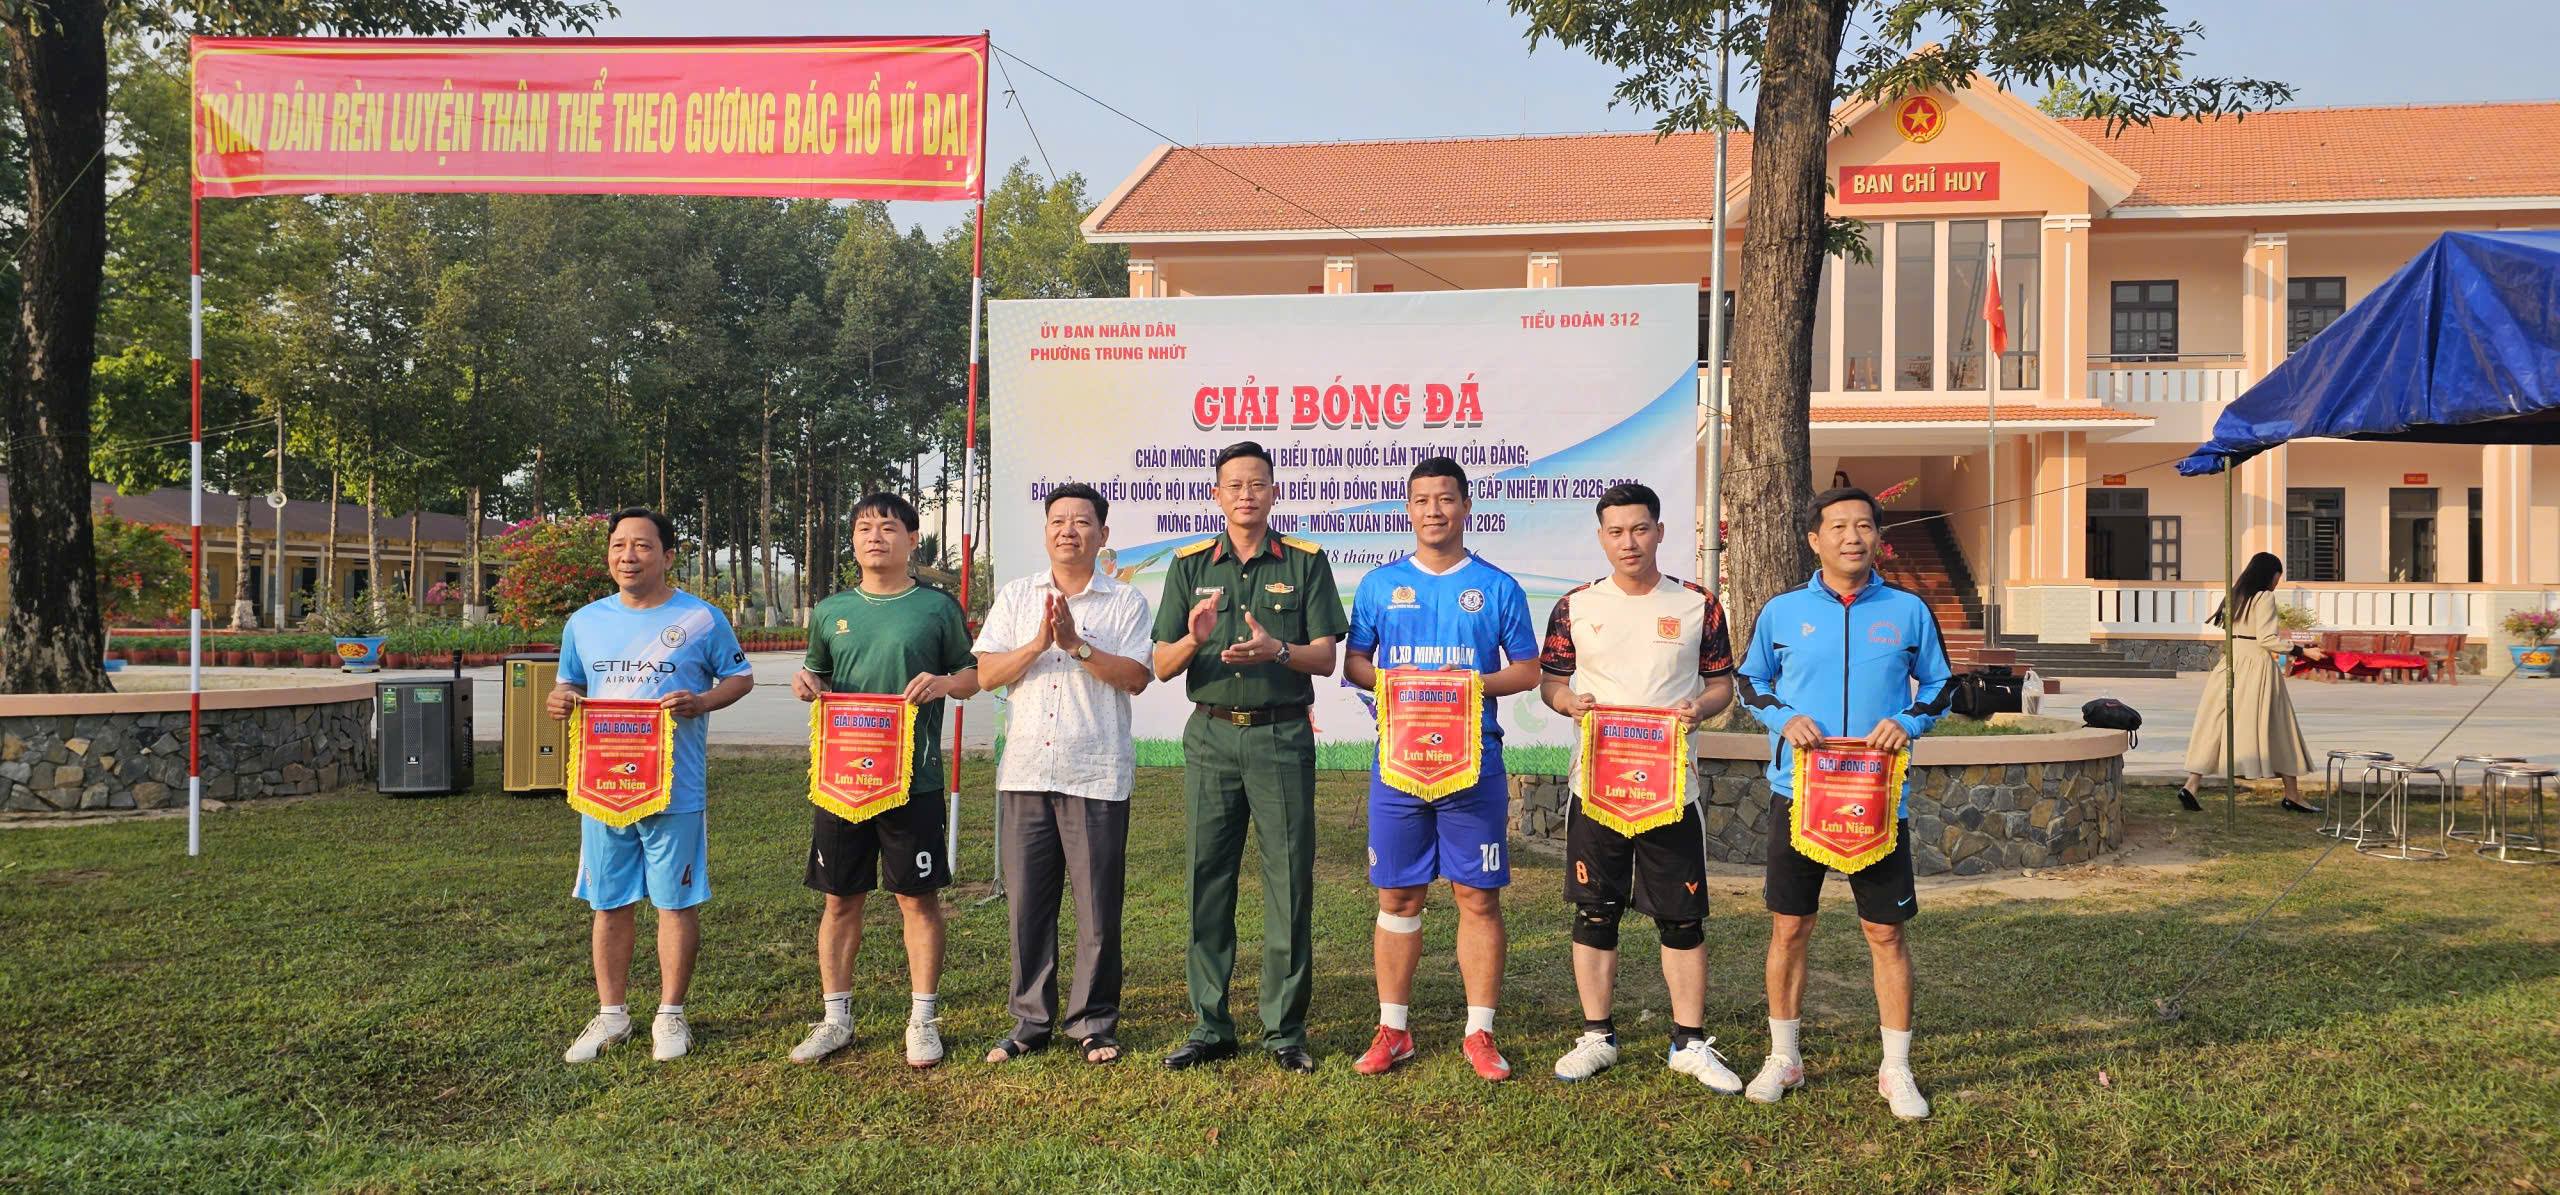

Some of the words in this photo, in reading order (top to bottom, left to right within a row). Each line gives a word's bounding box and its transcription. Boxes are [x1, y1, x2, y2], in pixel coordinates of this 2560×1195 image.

[200, 80, 265, 155] TOÀN
[268, 79, 325, 152] DÂN
[330, 79, 385, 152] RÈN
[390, 79, 475, 166] LUYỆN
[480, 79, 549, 152] THÂN
[557, 67, 608, 152] THỂ
[611, 92, 678, 153] THEO
[684, 86, 776, 154] GƯƠNG
[783, 79, 837, 154] BÁC
[845, 71, 882, 154] HỒ
[890, 80, 918, 155] VĨ
[922, 93, 969, 171] ĐẠI
[1853, 174, 1893, 194] BAN
[1902, 166, 1937, 193] CHỈ
[1944, 171, 1988, 192] HUY
[1040, 321, 1059, 339] ỦY
[1064, 325, 1094, 339] BAN
[1099, 322, 1141, 338] NHÂN
[1145, 322, 1176, 338] DÂN
[1520, 309, 1556, 329] TIỂU
[1560, 311, 1605, 328] ĐOÀN
[1609, 312, 1640, 327] 312
[1030, 344, 1091, 361] PHƯỜNG
[1095, 346, 1143, 361] TRUNG
[1149, 343, 1187, 360] NHỨT
[1192, 374, 1280, 430] GIẢI
[1291, 375, 1411, 430] BÓNG
[1424, 373, 1484, 428] ĐÁ
[1135, 445, 1166, 468] CHÀO
[1171, 446, 1206, 468] MỪNG
[1280, 440, 1308, 467] BIỂU
[1311, 444, 1343, 466] TOÀN
[1349, 441, 1379, 467] QUỐC
[1383, 440, 1407, 466] LẦN
[1462, 440, 1487, 466] CỦA
[1490, 439, 1529, 467] ĐẢNG;
[1101, 474, 1126, 500] BIỂU
[1131, 474, 1161, 502] QUỐC
[1166, 479, 1185, 505] HỘI
[1189, 477, 1217, 500] KHÓ
[1289, 474, 1316, 500] BIỂU
[1320, 478, 1340, 505] HỘI
[1344, 474, 1377, 500] ĐỒNG
[1381, 476, 1407, 500] NHÂ
[1478, 473, 1503, 499] CẤP
[1507, 476, 1548, 503] NHIỆM
[1553, 475, 1569, 499] KỲ
[1157, 510, 1190, 533] MỪNG
[1195, 508, 1225, 532] ĐẢNG
[1271, 514, 1298, 532] VINH
[1310, 511, 1344, 532] MỪNG
[1349, 510, 1382, 532] XUÂN
[1385, 510, 1412, 532] BÍNH
[1476, 513, 1506, 532] 2026
[1344, 547, 1383, 566] tháng
[592, 660, 676, 673] ETIHAD
[1415, 646, 1443, 664] MINH
[605, 676, 661, 684] AIRWAYS
[915, 851, 933, 878] 9
[1479, 843, 1500, 873] 10
[681, 863, 692, 889] 4
[1575, 860, 1589, 885] 8
